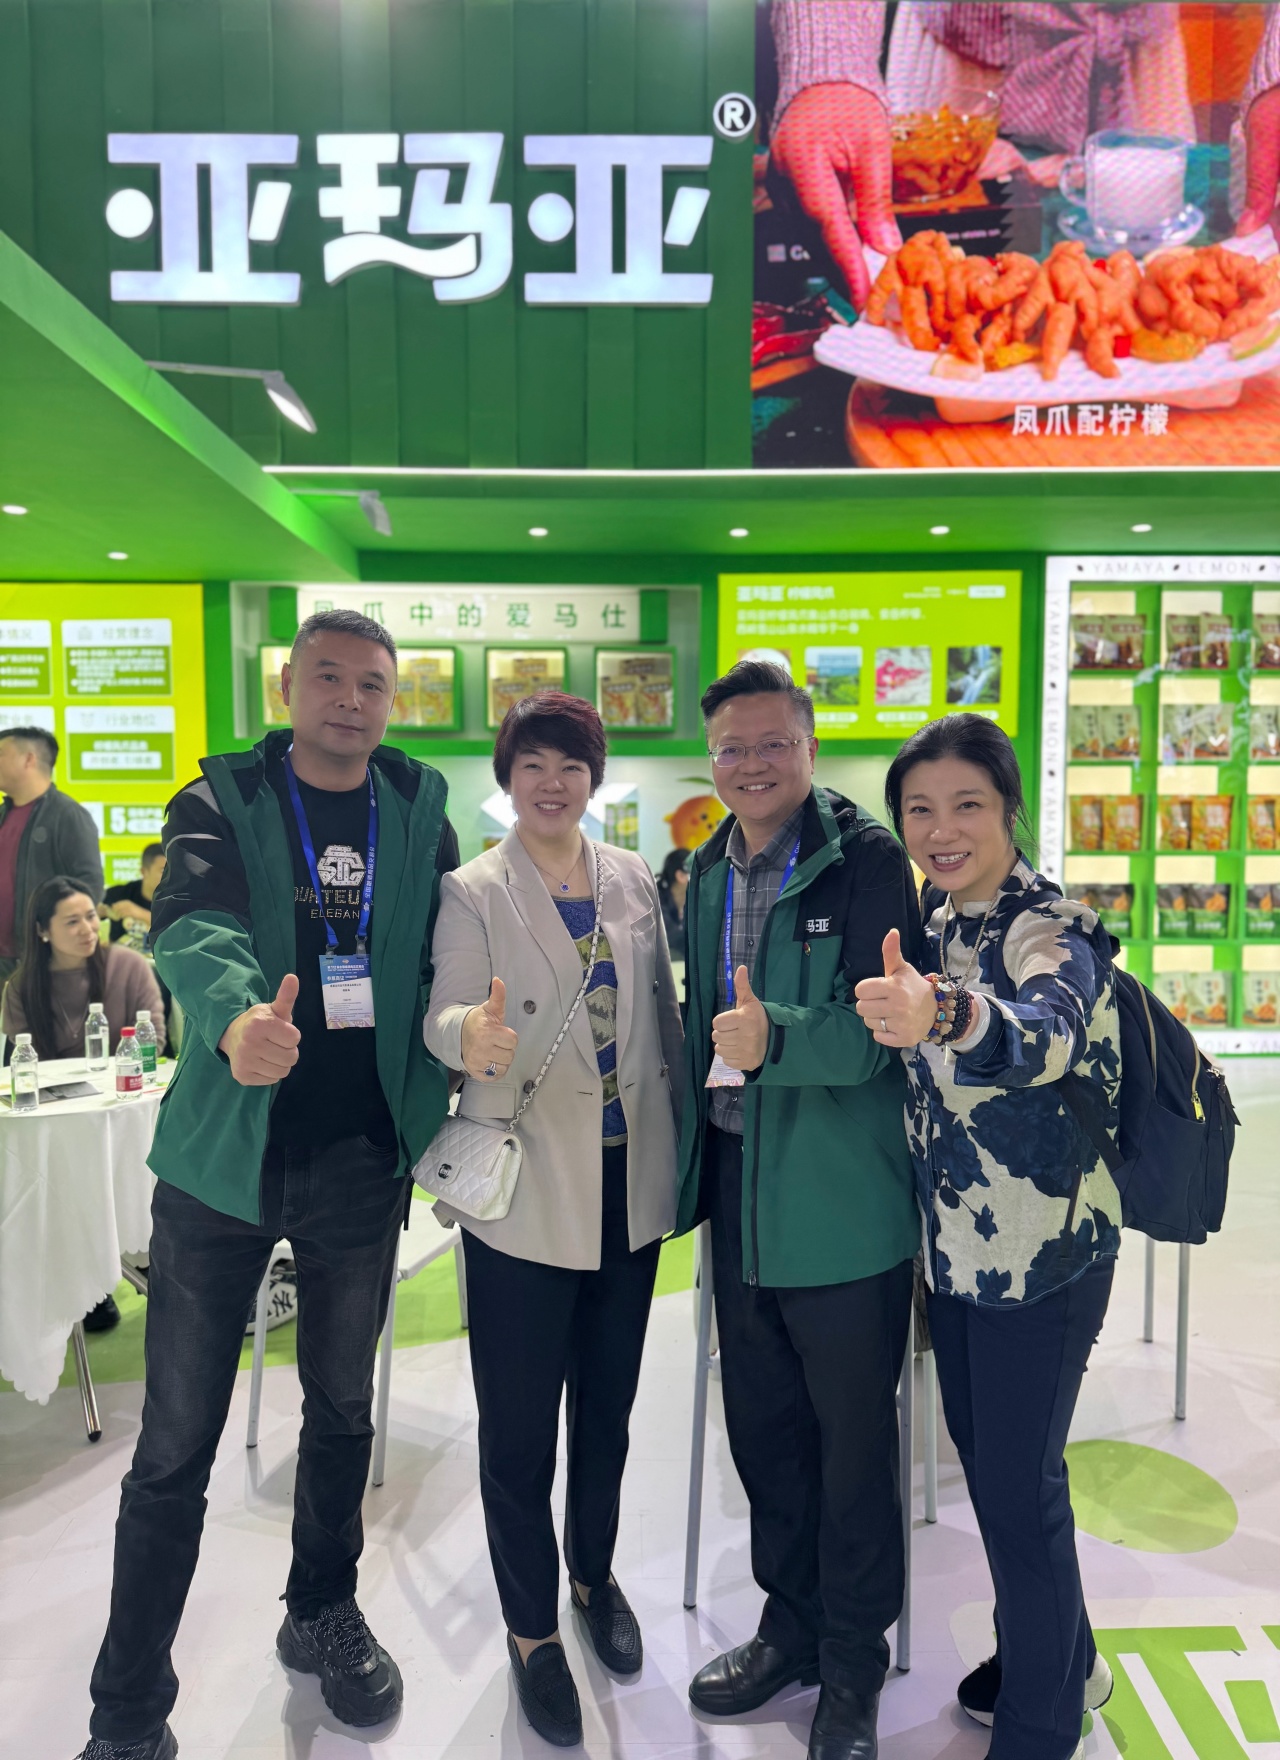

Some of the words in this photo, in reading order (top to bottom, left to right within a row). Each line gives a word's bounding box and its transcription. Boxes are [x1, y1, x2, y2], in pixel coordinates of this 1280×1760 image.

[105, 132, 713, 305] 亚玛亚
[1012, 404, 1170, 437] 凤爪配柠檬
[1092, 562, 1165, 574] YAMAYA
[1187, 561, 1252, 574] LEMON
[1048, 599, 1060, 674] YAMAYA
[1046, 697, 1059, 763] LEMON
